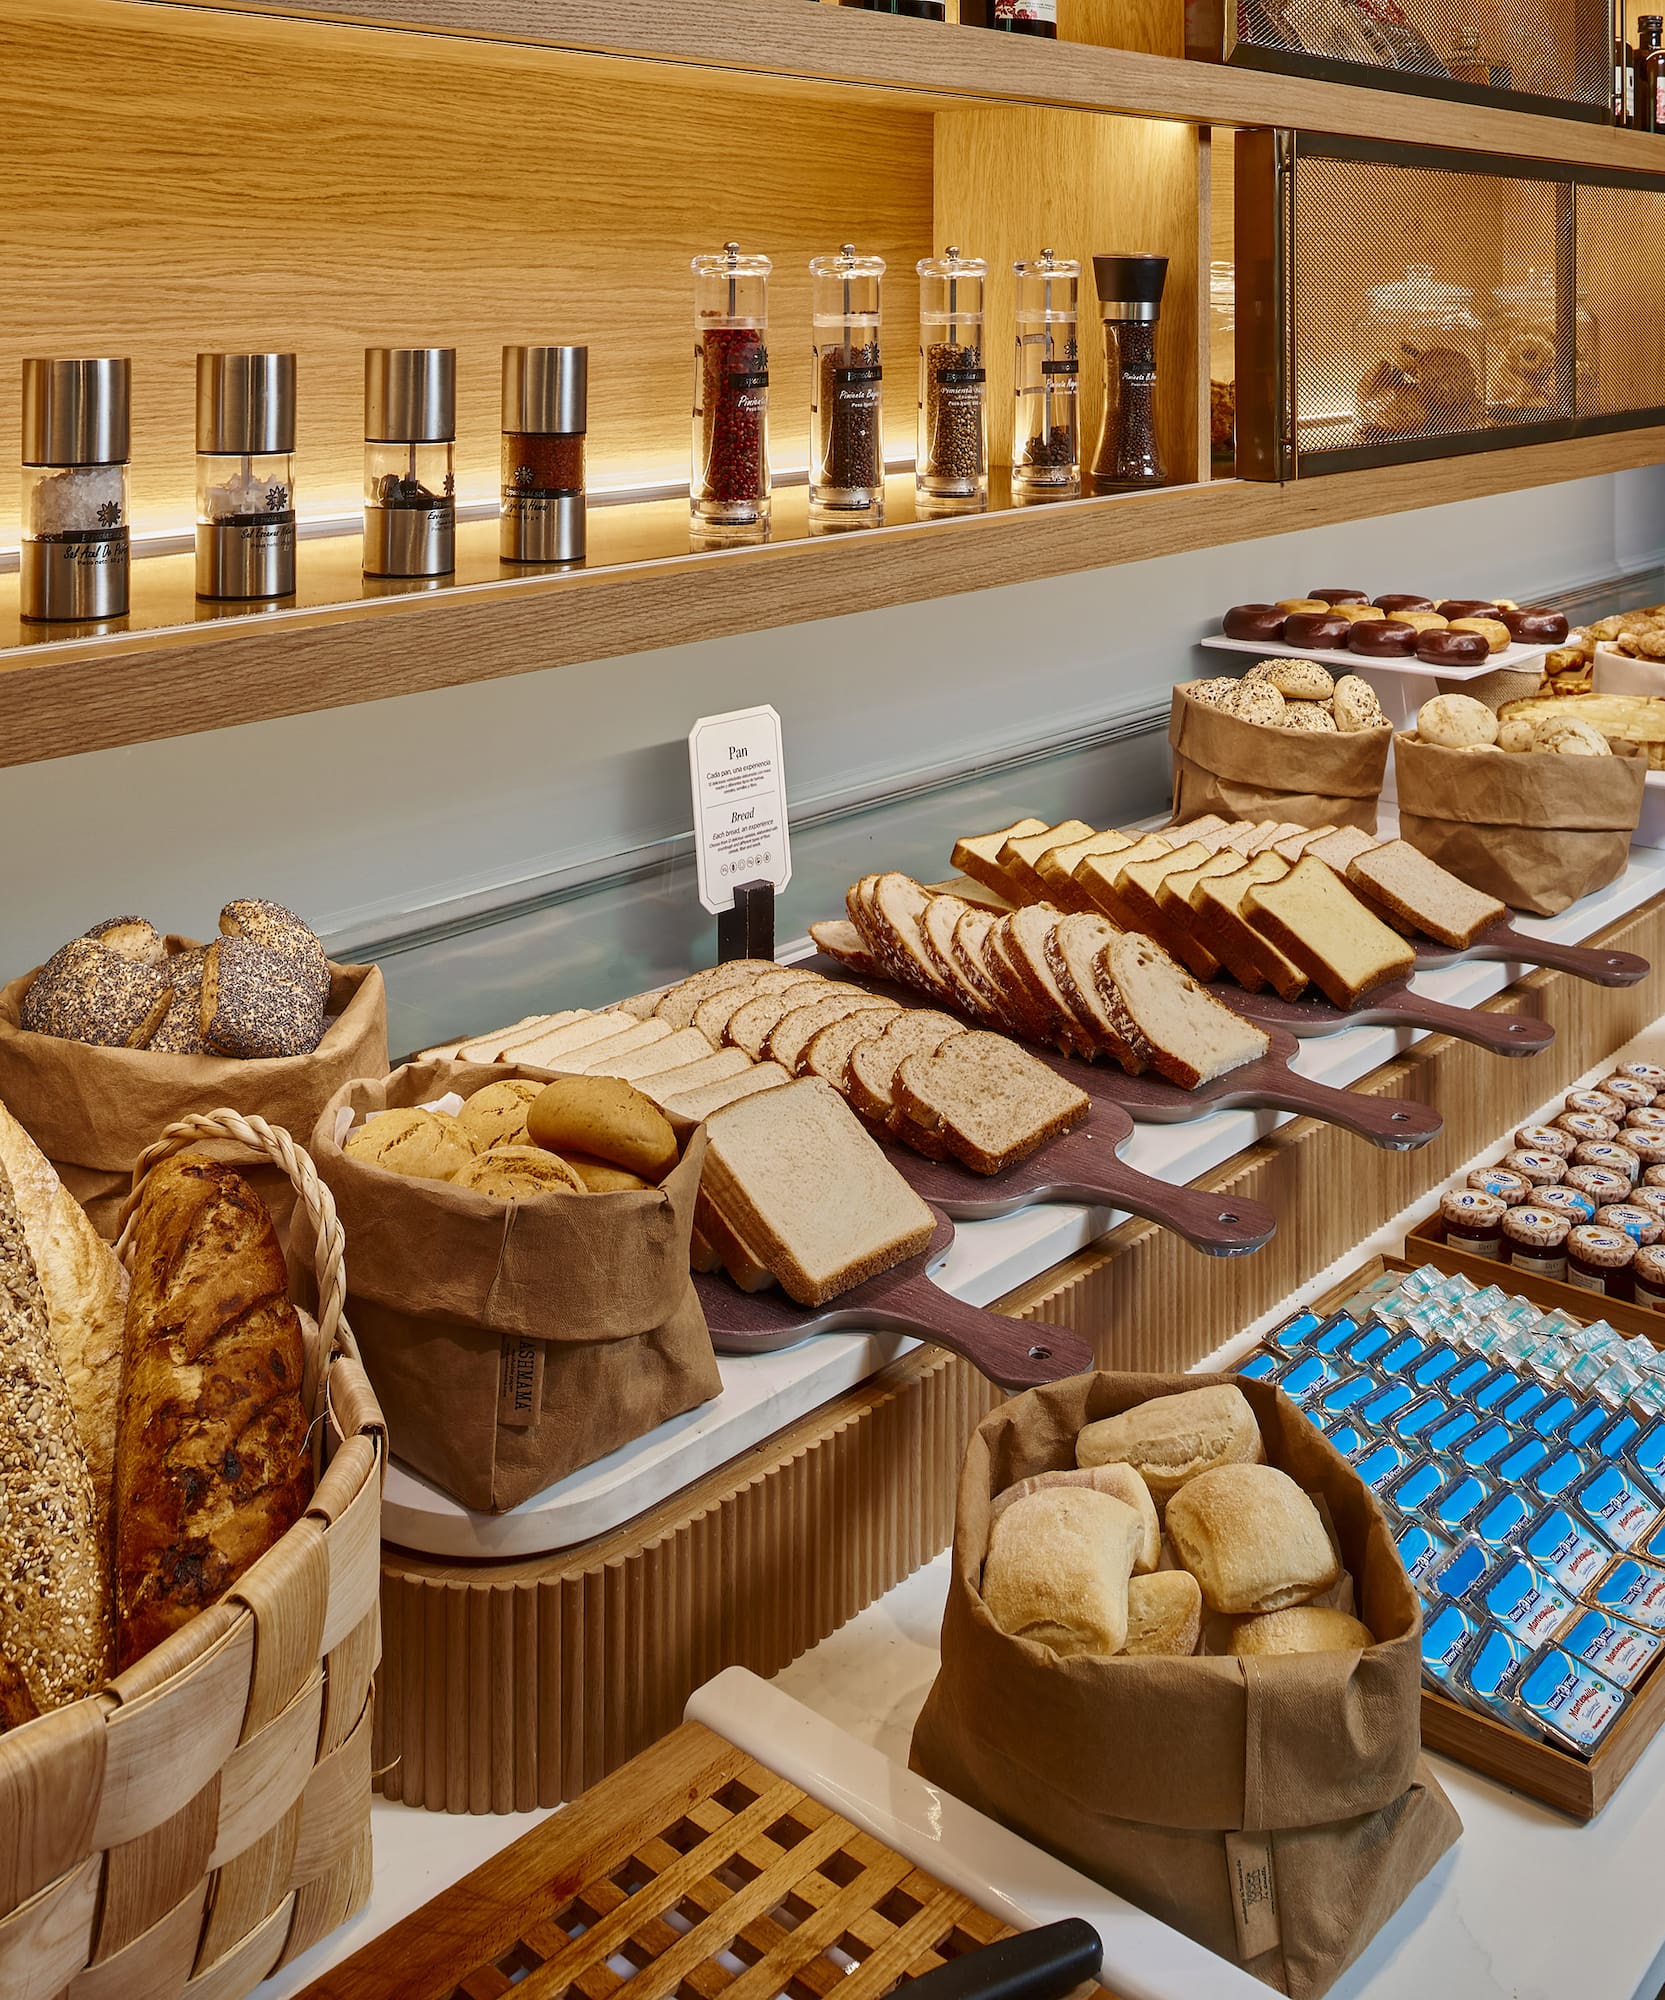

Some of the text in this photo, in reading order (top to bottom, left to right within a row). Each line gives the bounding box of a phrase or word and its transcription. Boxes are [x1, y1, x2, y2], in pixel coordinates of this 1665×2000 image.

[64, 544, 80, 560] Sal
[728, 745, 748, 760] Pan
[706, 771, 720, 780] Cada
[733, 767, 743, 775] una
[743, 760, 771, 772] experiencia
[731, 806, 755, 823] Bread
[712, 831, 725, 841] Each
[741, 825, 748, 833] an
[748, 819, 774, 831] experience
[1528, 1603, 1556, 1636] Mantequilla
[1604, 1636, 1634, 1665] Mantequilla
[1568, 1687, 1599, 1721] Mantequilla
